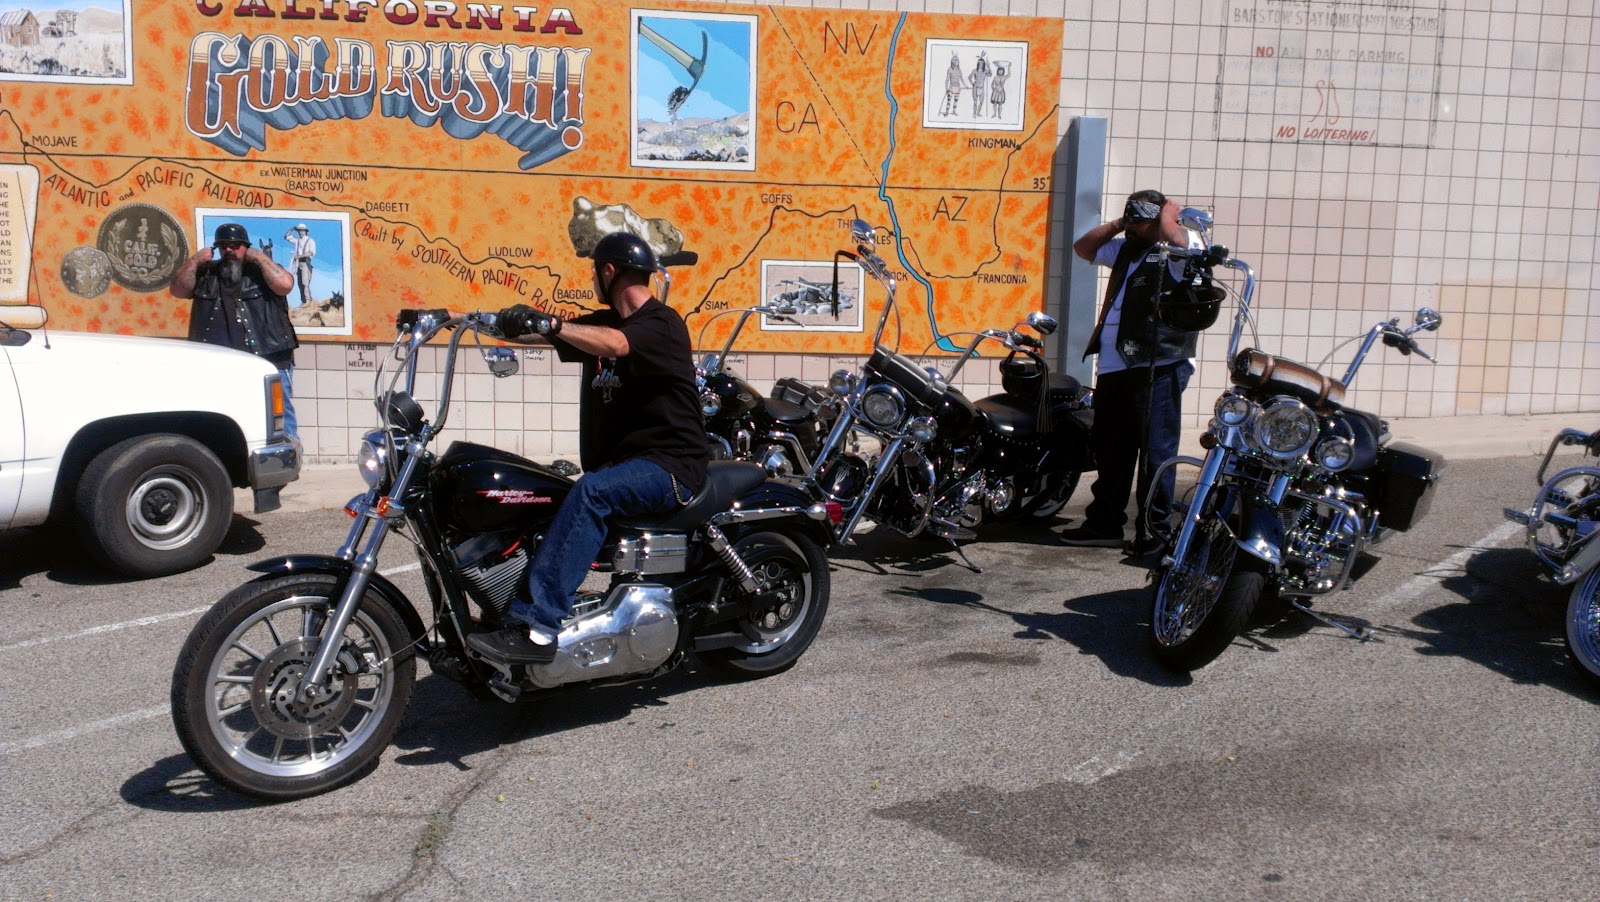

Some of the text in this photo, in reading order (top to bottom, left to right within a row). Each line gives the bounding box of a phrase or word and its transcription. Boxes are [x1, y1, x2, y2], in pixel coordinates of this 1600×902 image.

[824, 21, 878, 55] NV
[1256, 46, 1274, 58] NO
[186, 32, 592, 156] GOLD RUSH!
[776, 101, 821, 134] CA
[1277, 126, 1296, 138] NO
[32, 136, 78, 148] MOJAVE
[968, 138, 1017, 149] KINGMAN
[271, 167, 322, 179] WATERMAN
[326, 170, 367, 181] JUNCTION
[45, 166, 274, 208] ATLANTIC and PACIFIC RAILROAD
[285, 179, 344, 194] (BARSTOW)
[761, 193, 793, 204] GOFFS
[366, 202, 410, 213] DAGGETT
[933, 196, 968, 222] AZ
[488, 247, 533, 258] LUDLOW
[392, 230, 404, 247] by
[411, 244, 476, 284] SOUTHERN
[482, 269, 528, 296] PACIFIC
[557, 288, 594, 300] BAGDAD
[705, 300, 729, 310] SIAM
[499, 496, 553, 504] Davidson
